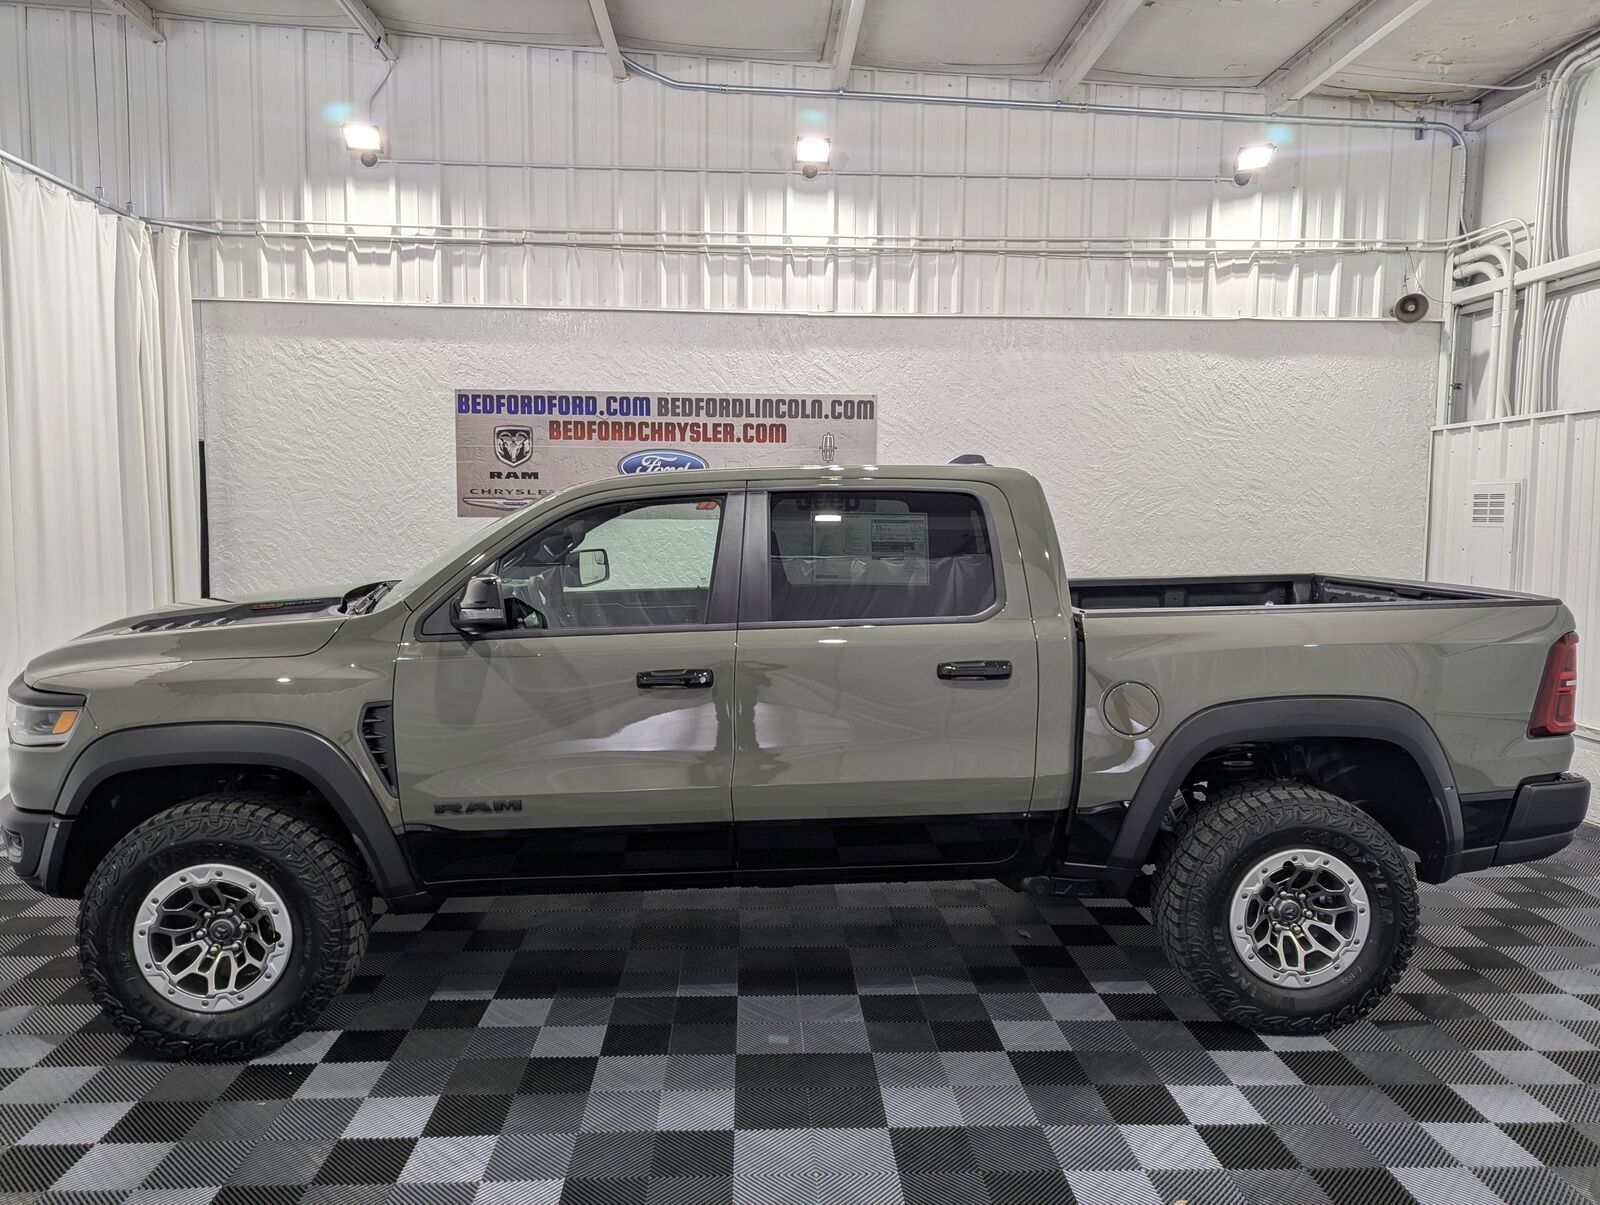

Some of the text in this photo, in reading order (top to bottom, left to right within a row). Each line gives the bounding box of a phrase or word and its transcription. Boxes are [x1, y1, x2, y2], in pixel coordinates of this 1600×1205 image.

[457, 394, 875, 420] BEDFORDFORD.COM BEDFORDLINCOLN.COM
[548, 420, 787, 443] BEDFORDCHRYSLER.COM
[489, 471, 539, 480] RAM
[434, 800, 523, 814] RAM
